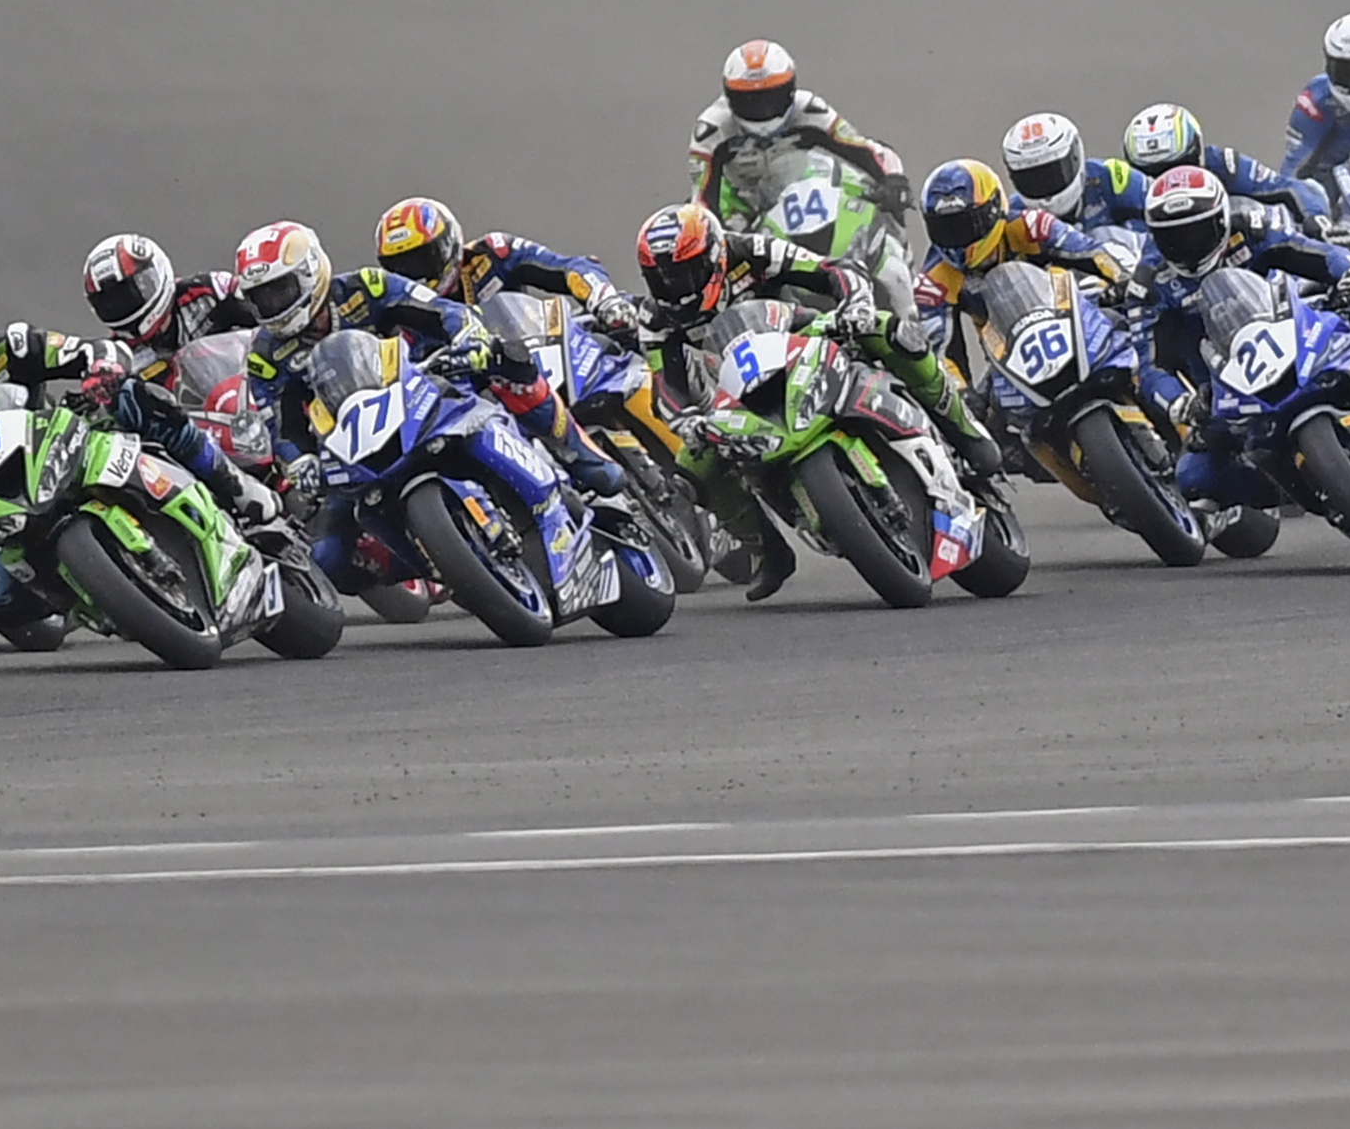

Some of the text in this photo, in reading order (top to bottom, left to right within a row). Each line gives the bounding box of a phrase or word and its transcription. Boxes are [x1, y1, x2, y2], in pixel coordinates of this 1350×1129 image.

[783, 188, 828, 231] 64
[733, 340, 759, 383] 5
[1020, 323, 1068, 379] 56
[1237, 329, 1284, 386] 21
